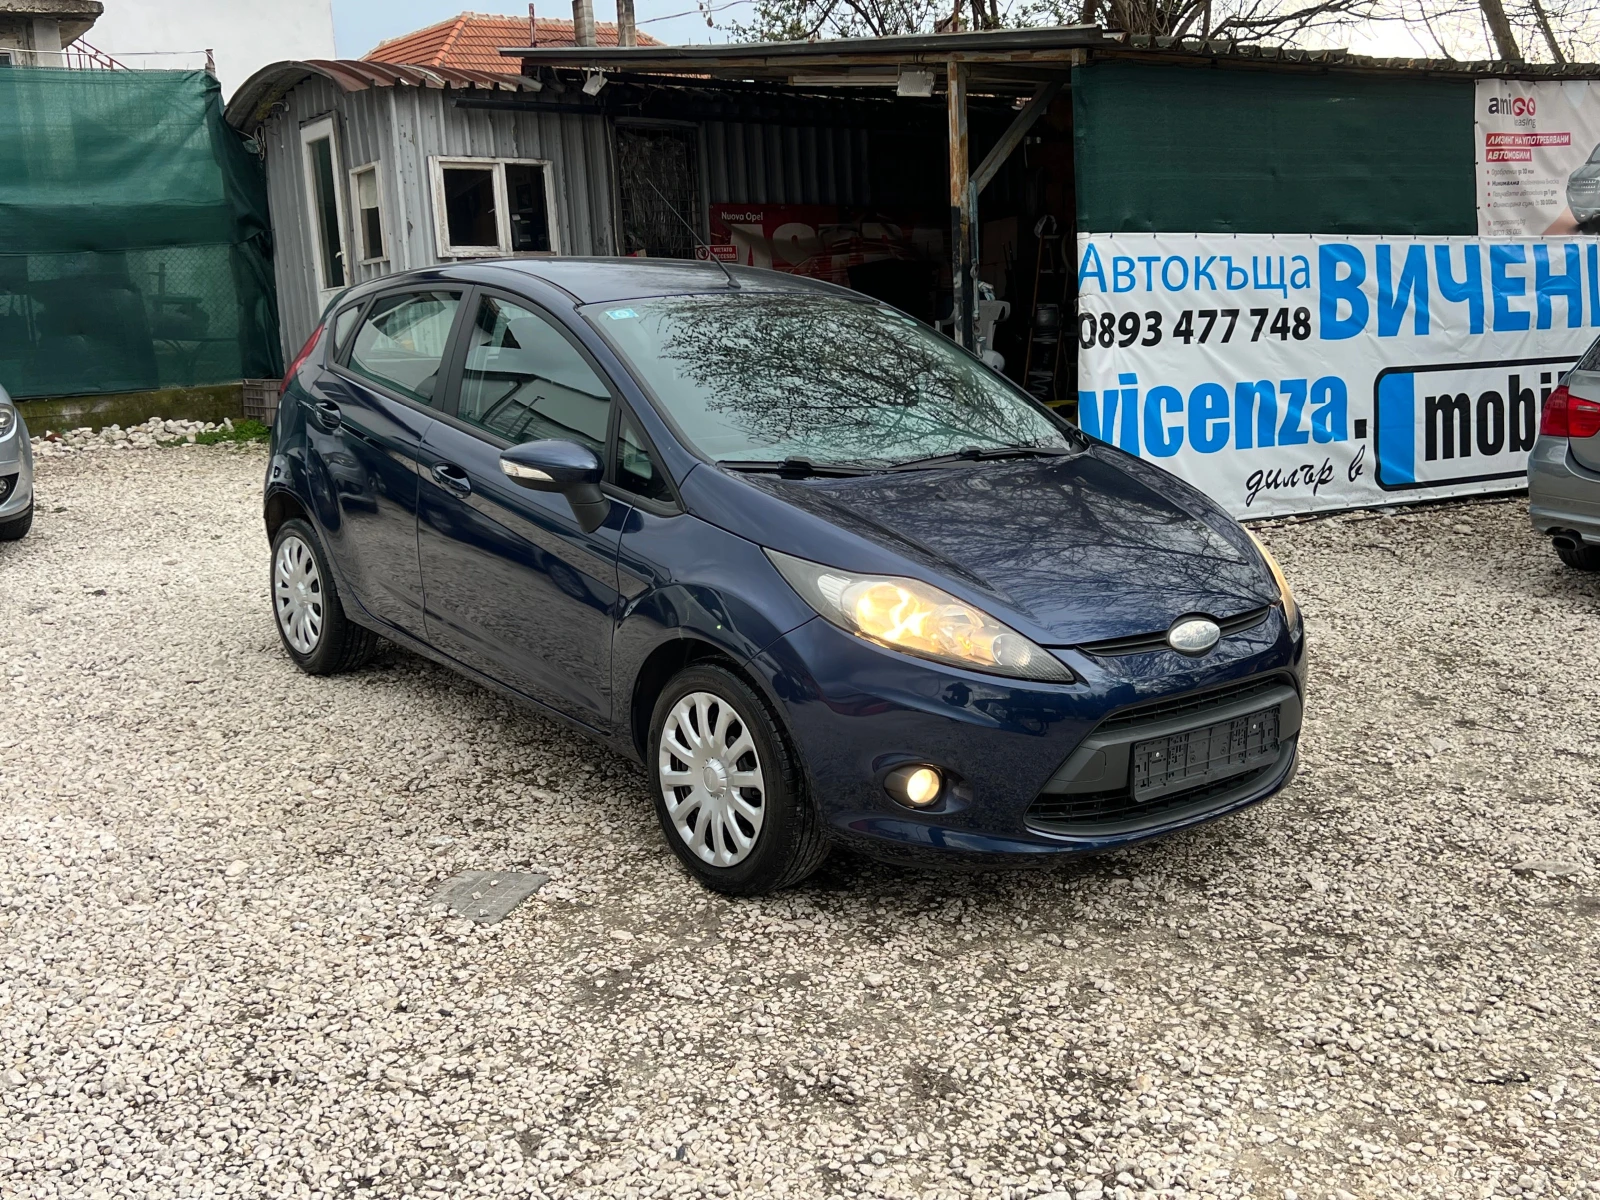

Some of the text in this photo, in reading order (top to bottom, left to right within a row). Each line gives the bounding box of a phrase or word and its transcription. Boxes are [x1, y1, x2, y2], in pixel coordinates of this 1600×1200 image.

[1513, 117, 1536, 129] leasing
[1488, 135, 1514, 145] ЛИЗИНГ
[1487, 151, 1531, 160] АВТОМОБИЛИ
[721, 211, 764, 222] Nuova Opel
[1077, 242, 1312, 299] Автокъща
[1318, 243, 1600, 340] ВИЧЕН
[1077, 306, 1312, 350] 0893 477 748
[1245, 457, 1335, 507] дилър
